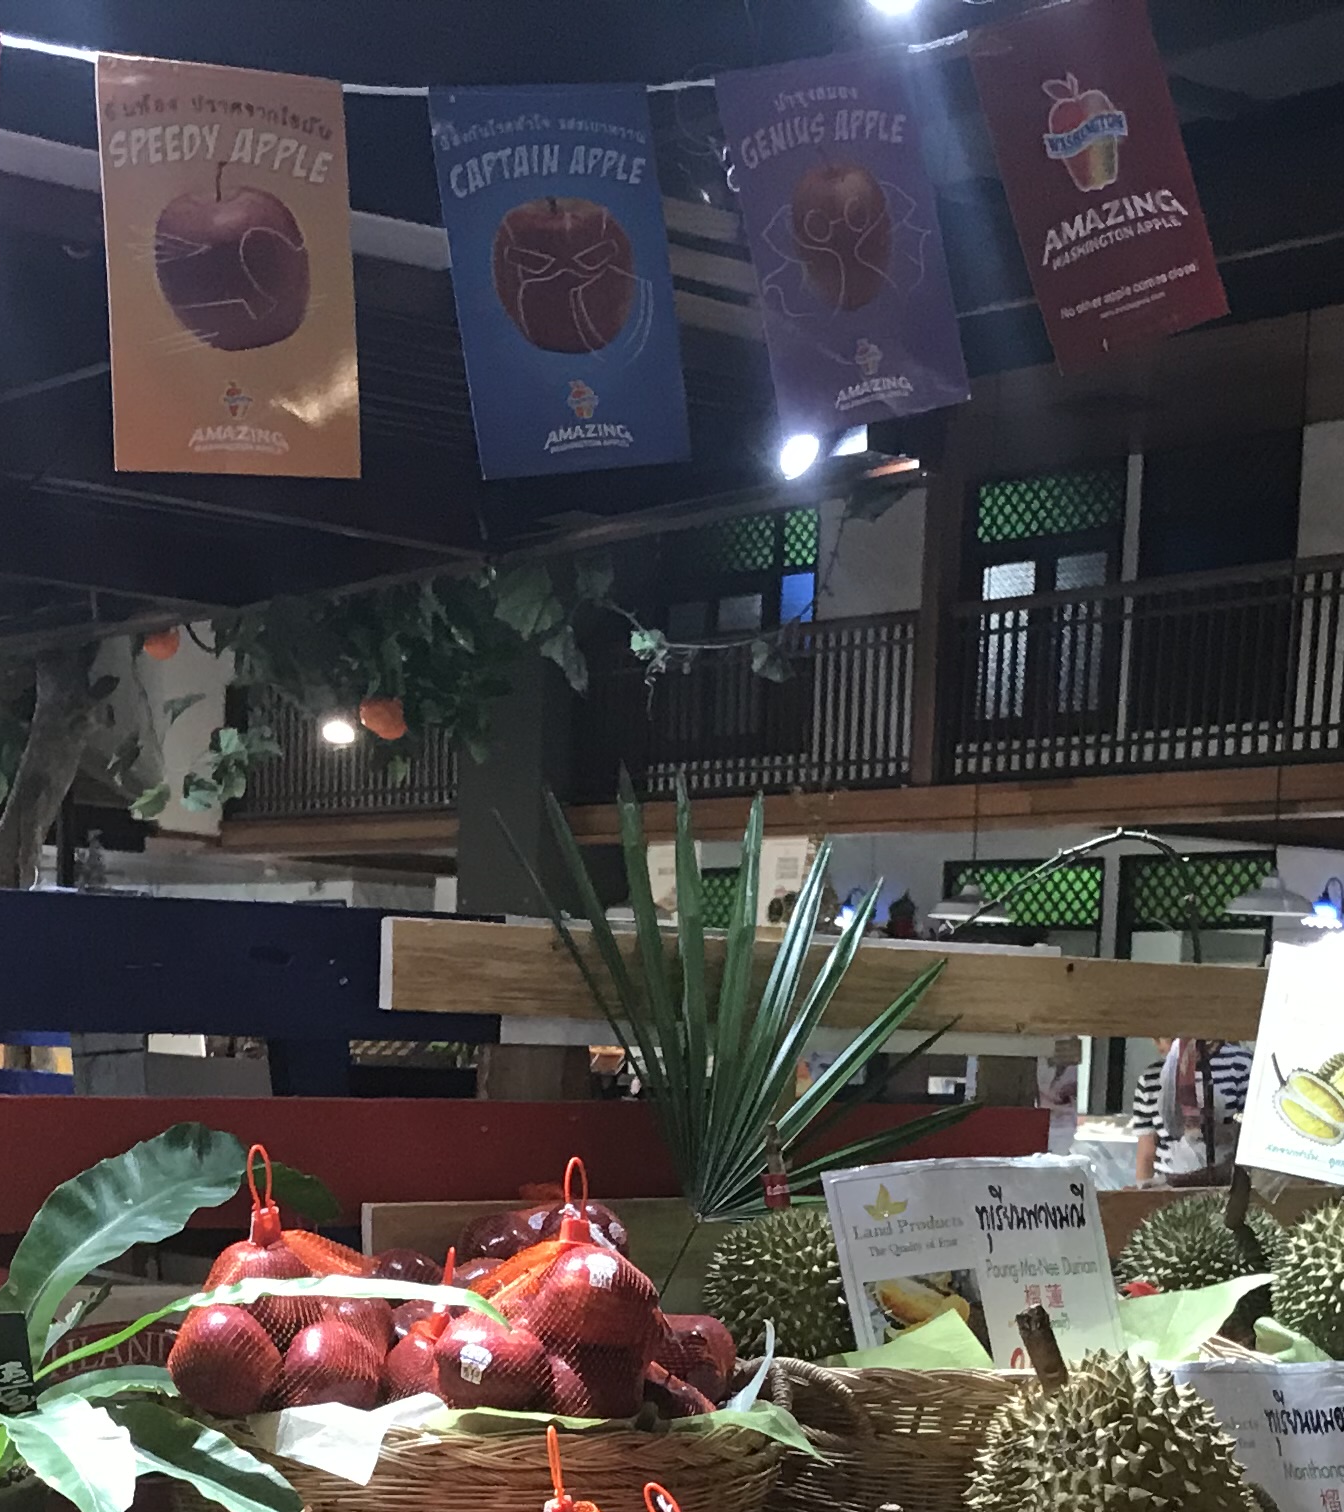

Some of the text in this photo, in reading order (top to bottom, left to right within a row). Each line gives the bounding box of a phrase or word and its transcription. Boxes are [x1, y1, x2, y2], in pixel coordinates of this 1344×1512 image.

[108, 123, 334, 184] SPEEDY APPLE
[740, 109, 906, 170] GENIUS APPLE
[449, 144, 647, 199] CAPTAIN APPLE
[1041, 188, 1190, 267] AMAZING
[1052, 214, 1183, 271] WASHINGTON APPLE
[1060, 306, 1076, 319] No
[834, 376, 914, 409] AMAZING
[187, 424, 290, 452] AMAZING
[543, 423, 635, 451] AMAZING
[851, 1214, 965, 1241] Land Products
